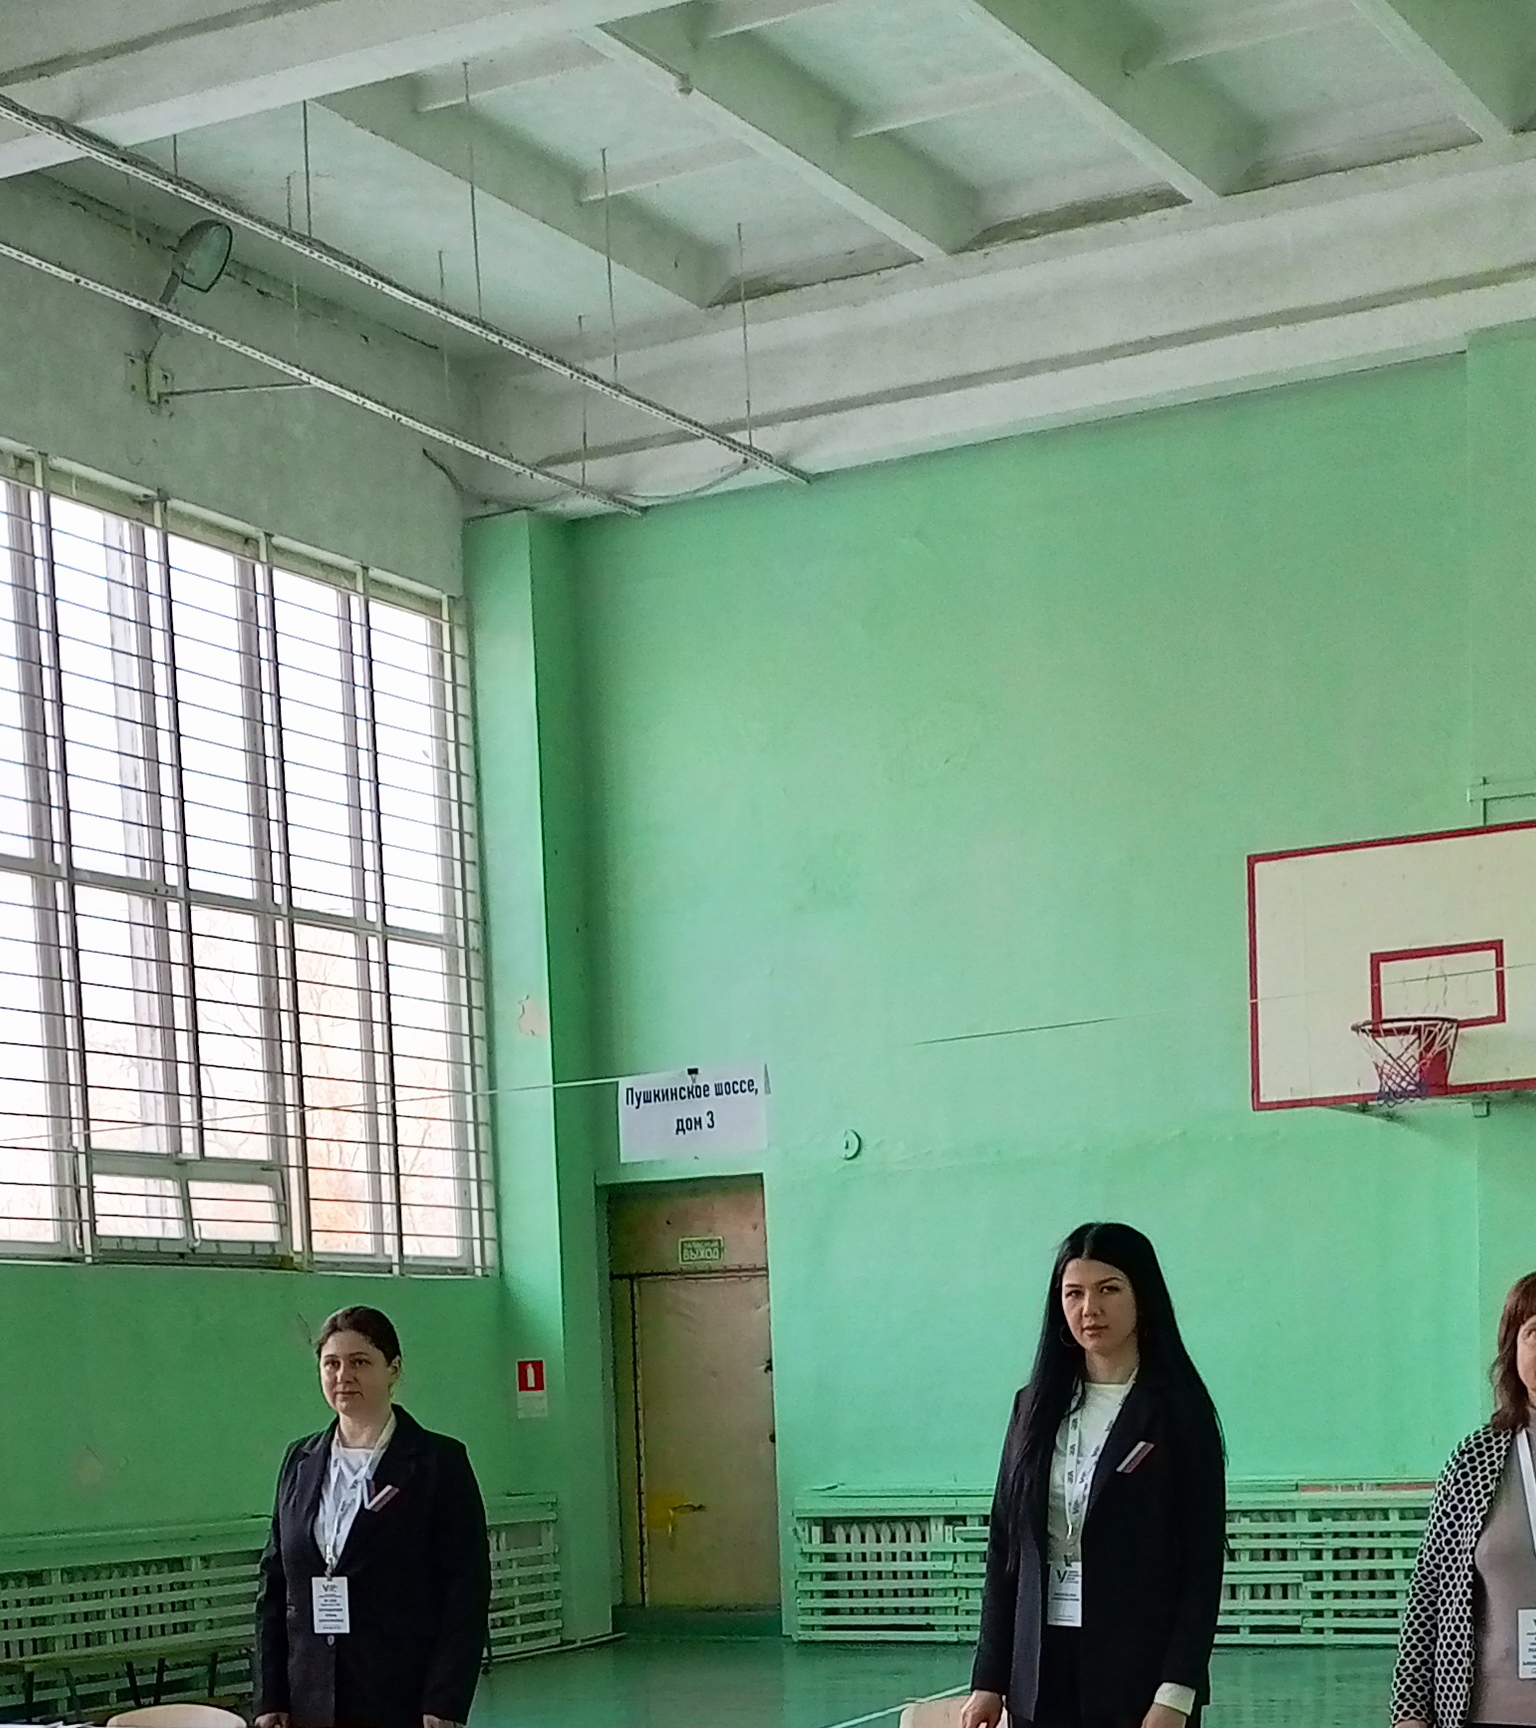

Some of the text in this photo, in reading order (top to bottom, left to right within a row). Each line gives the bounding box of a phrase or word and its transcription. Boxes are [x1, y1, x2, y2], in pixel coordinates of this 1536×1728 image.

[625, 1078, 759, 1110] Пушкинское шоссе,
[675, 1110, 715, 1136] дом 3
